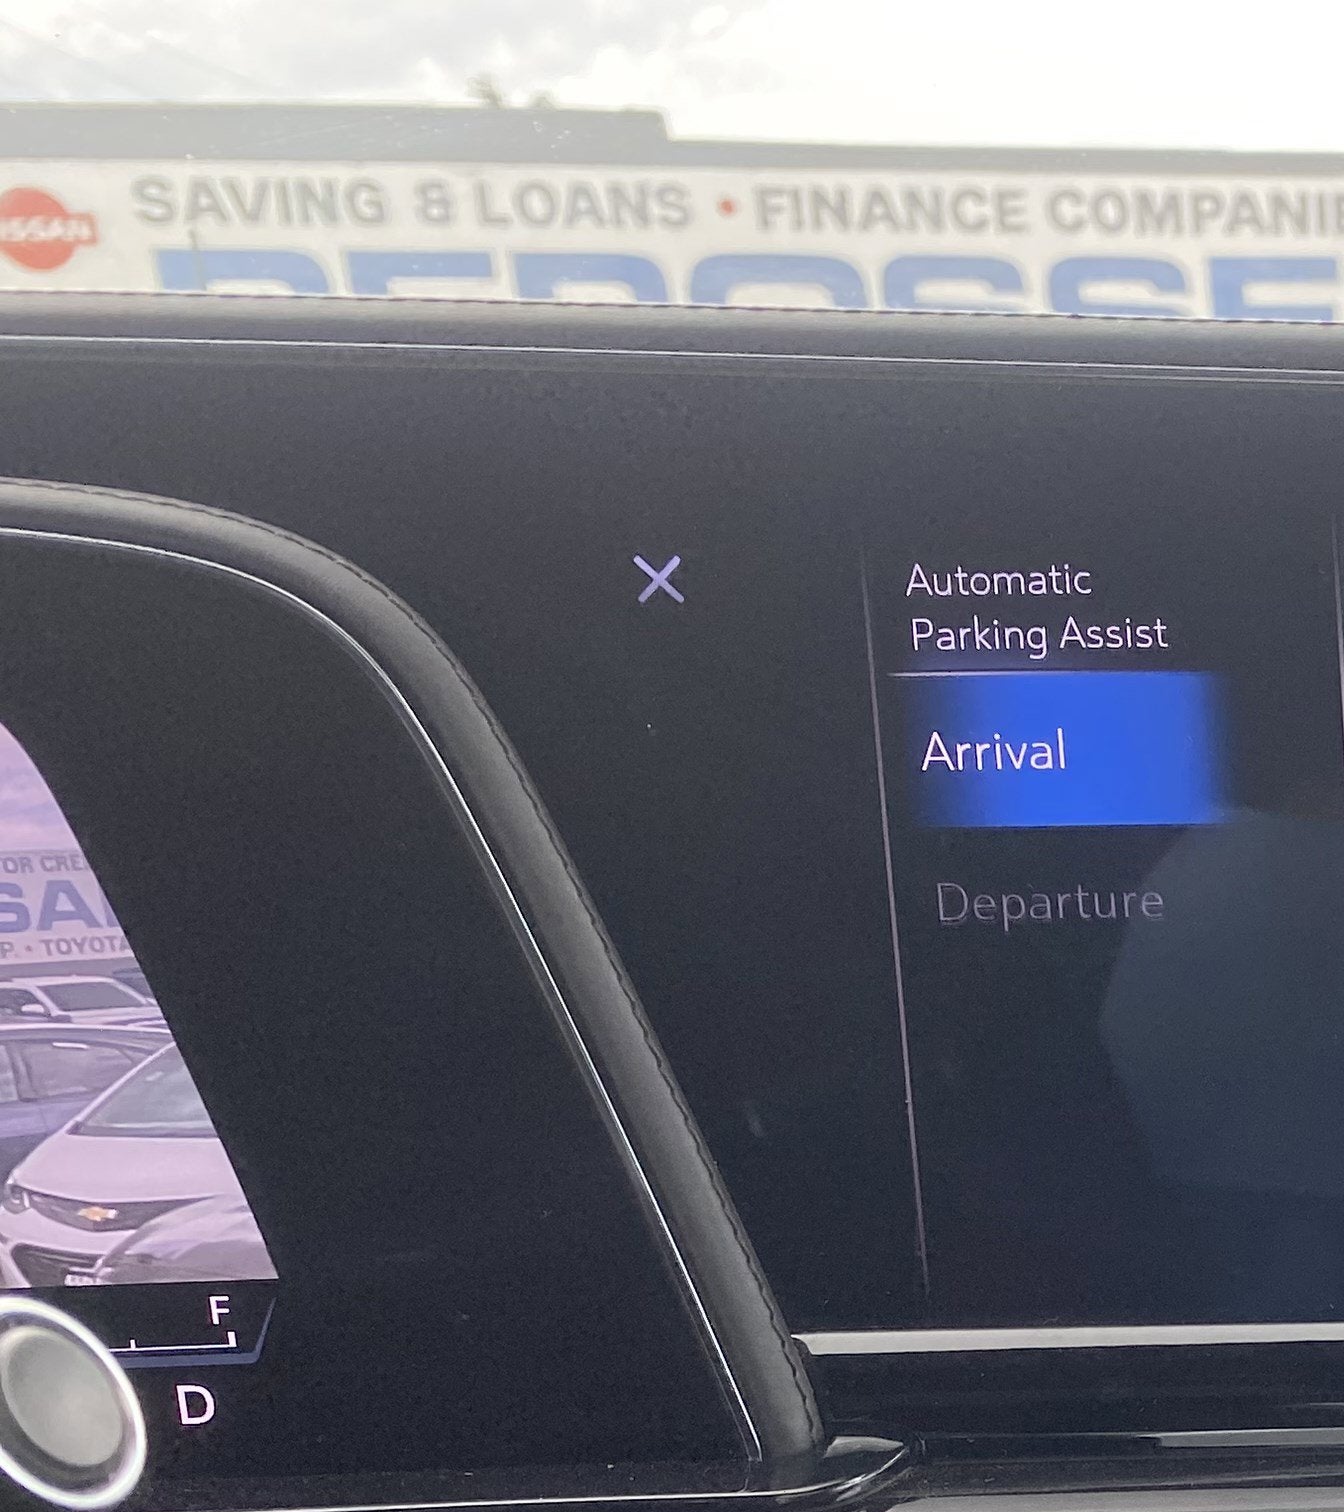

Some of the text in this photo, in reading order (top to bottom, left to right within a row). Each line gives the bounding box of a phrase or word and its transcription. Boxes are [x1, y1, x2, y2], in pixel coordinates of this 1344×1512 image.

[133, 175, 386, 229] SAVING
[474, 180, 692, 231] LOANS
[754, 184, 1029, 234] FINANCE
[906, 563, 1093, 596] Automatic
[912, 614, 1169, 660] Parking Assist
[921, 727, 1066, 772] Arrival
[936, 881, 1165, 932] Departure
[208, 1295, 230, 1325] F
[176, 1384, 215, 1426] D
